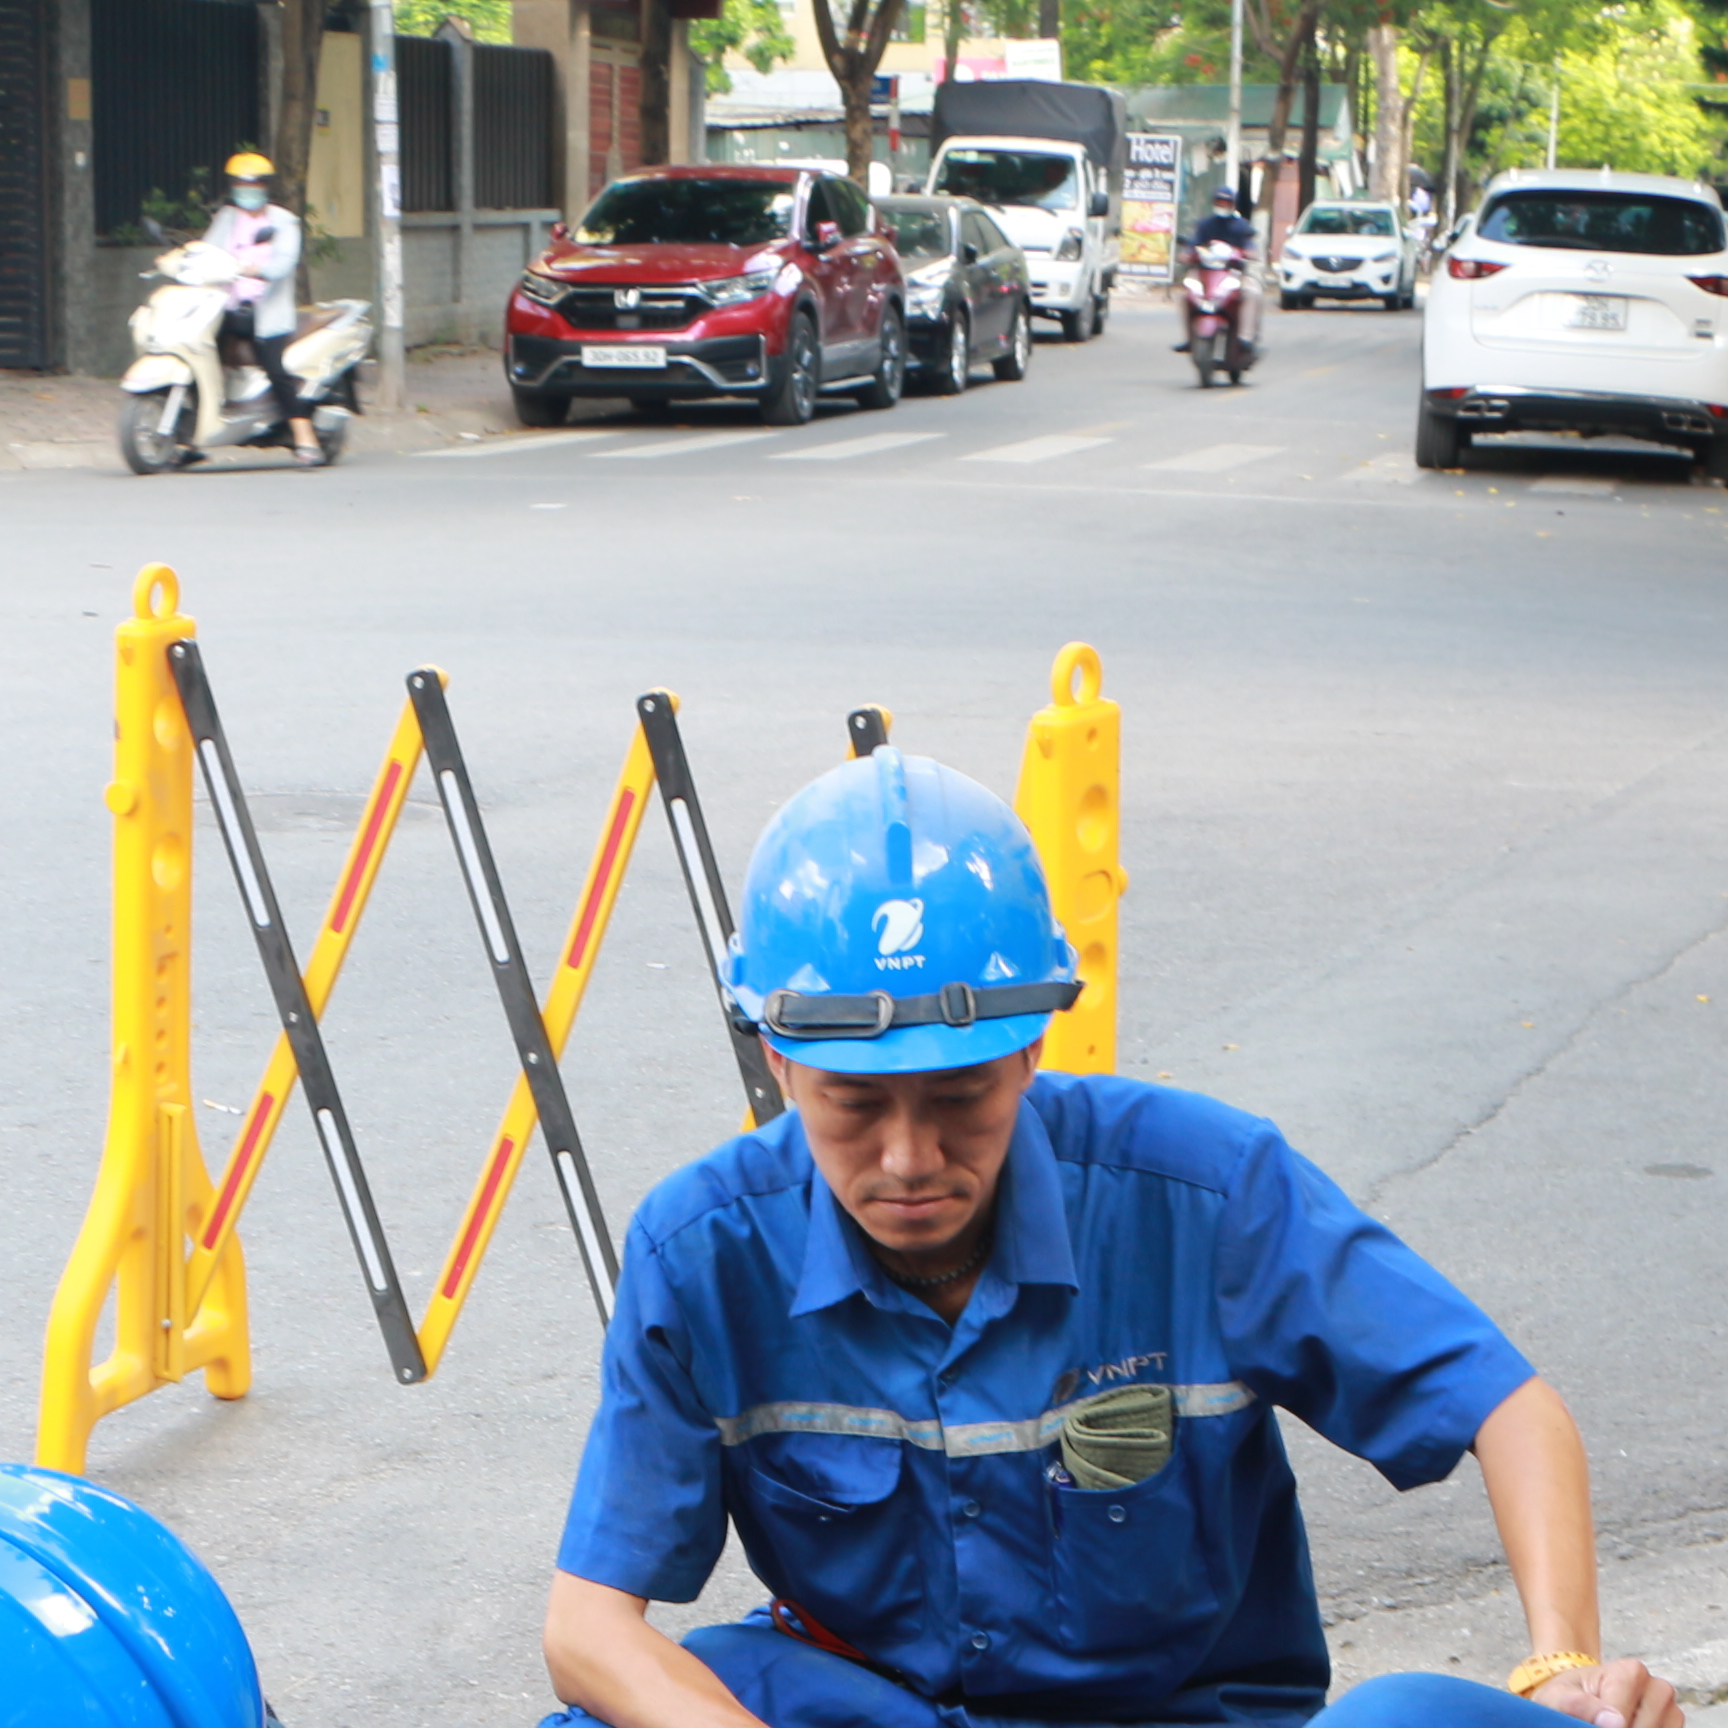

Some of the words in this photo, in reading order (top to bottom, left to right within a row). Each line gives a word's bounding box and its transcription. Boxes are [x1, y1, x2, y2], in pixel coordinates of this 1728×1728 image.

[1130, 137, 1175, 164] Hotel
[874, 954, 927, 972] VNPT
[1087, 1351, 1168, 1386] VNPT
